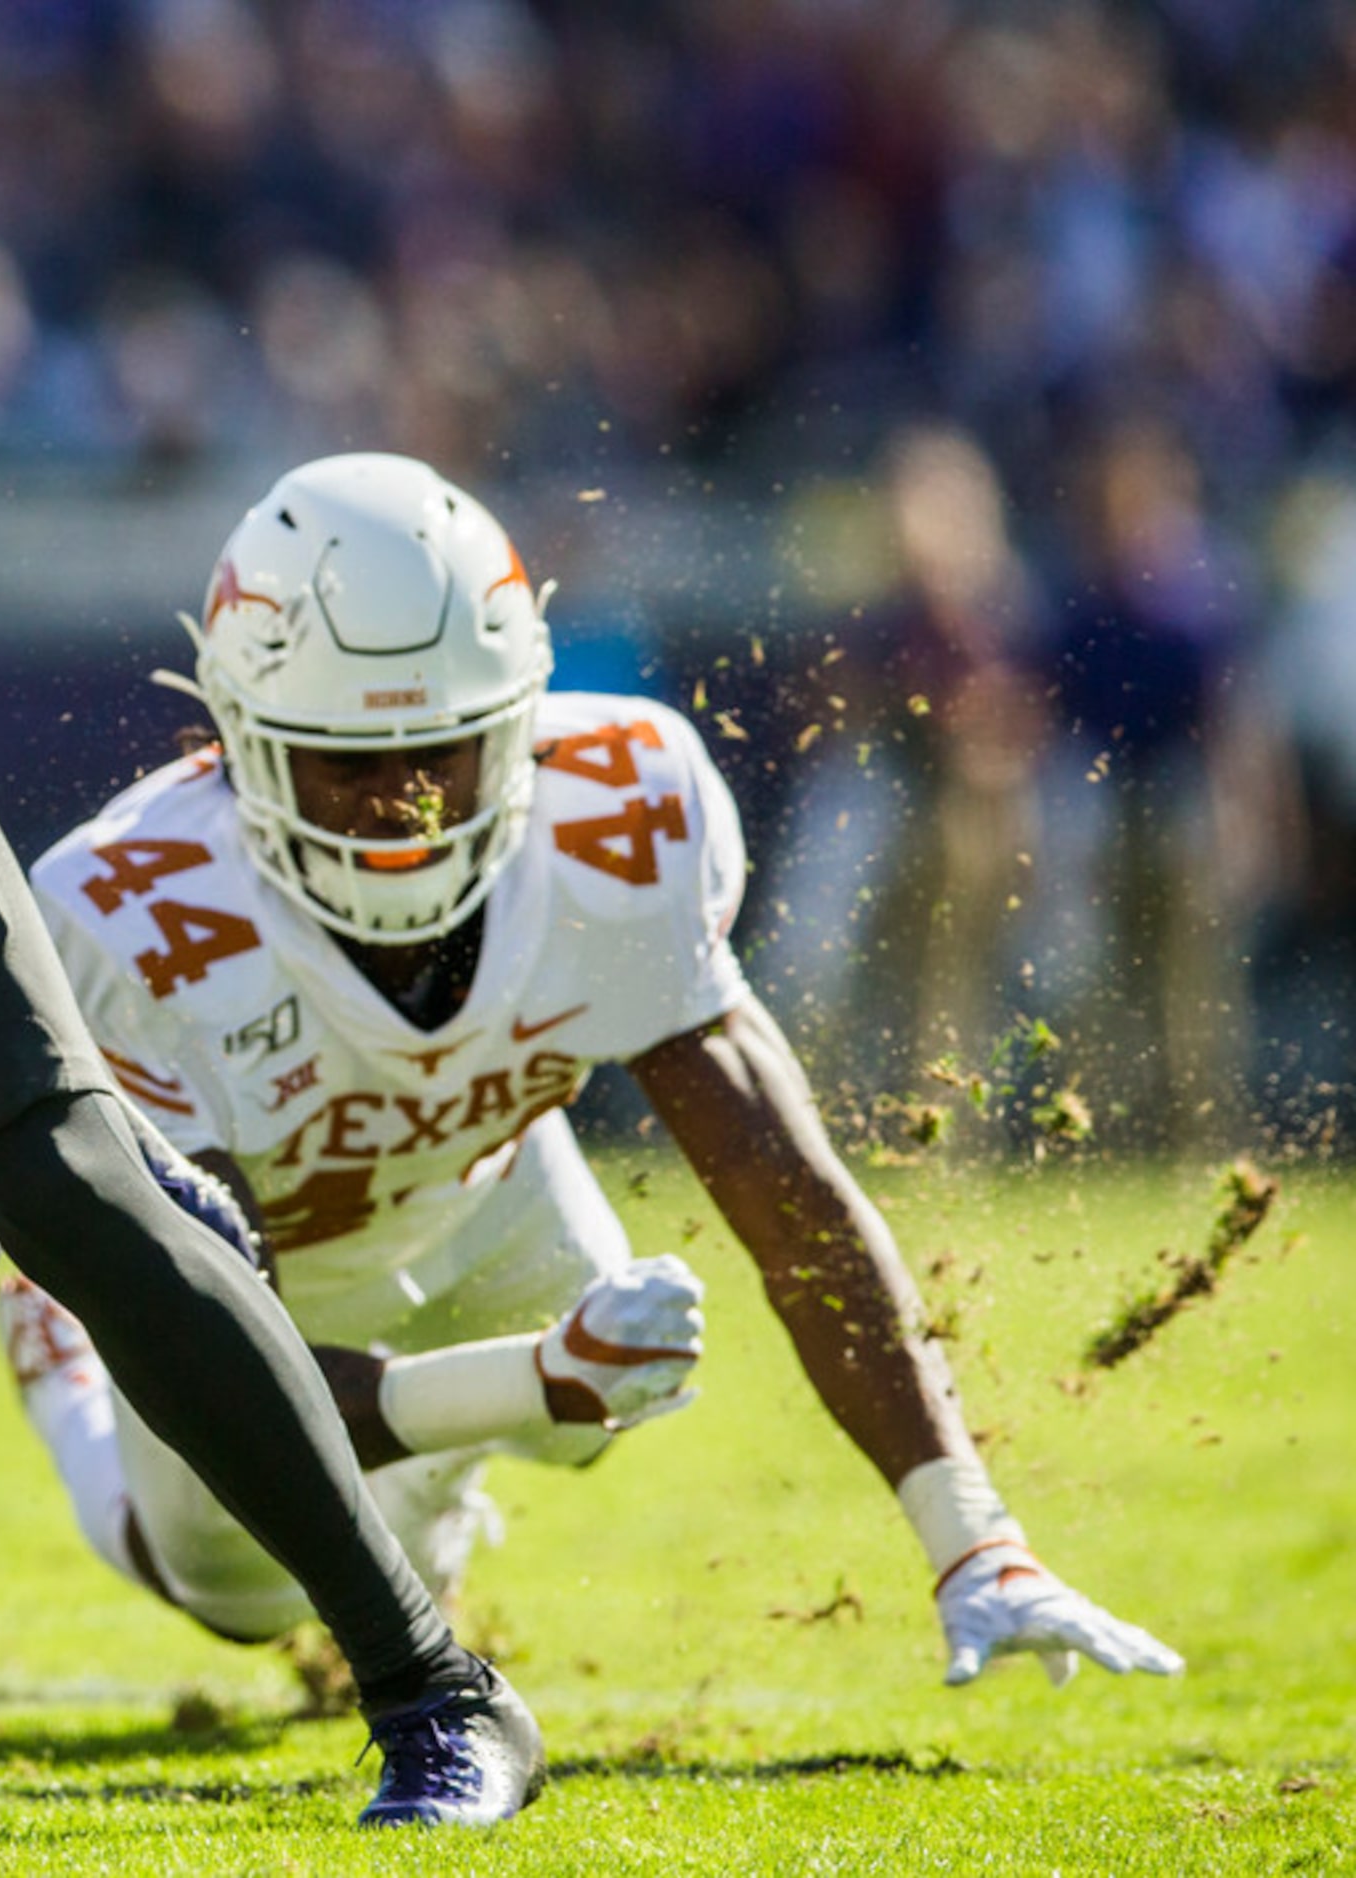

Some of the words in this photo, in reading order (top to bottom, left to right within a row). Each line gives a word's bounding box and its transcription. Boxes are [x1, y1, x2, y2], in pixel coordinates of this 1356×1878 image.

[533, 720, 688, 887] 44
[81, 838, 263, 1001] 44
[272, 1050, 578, 1168] TEXAS
